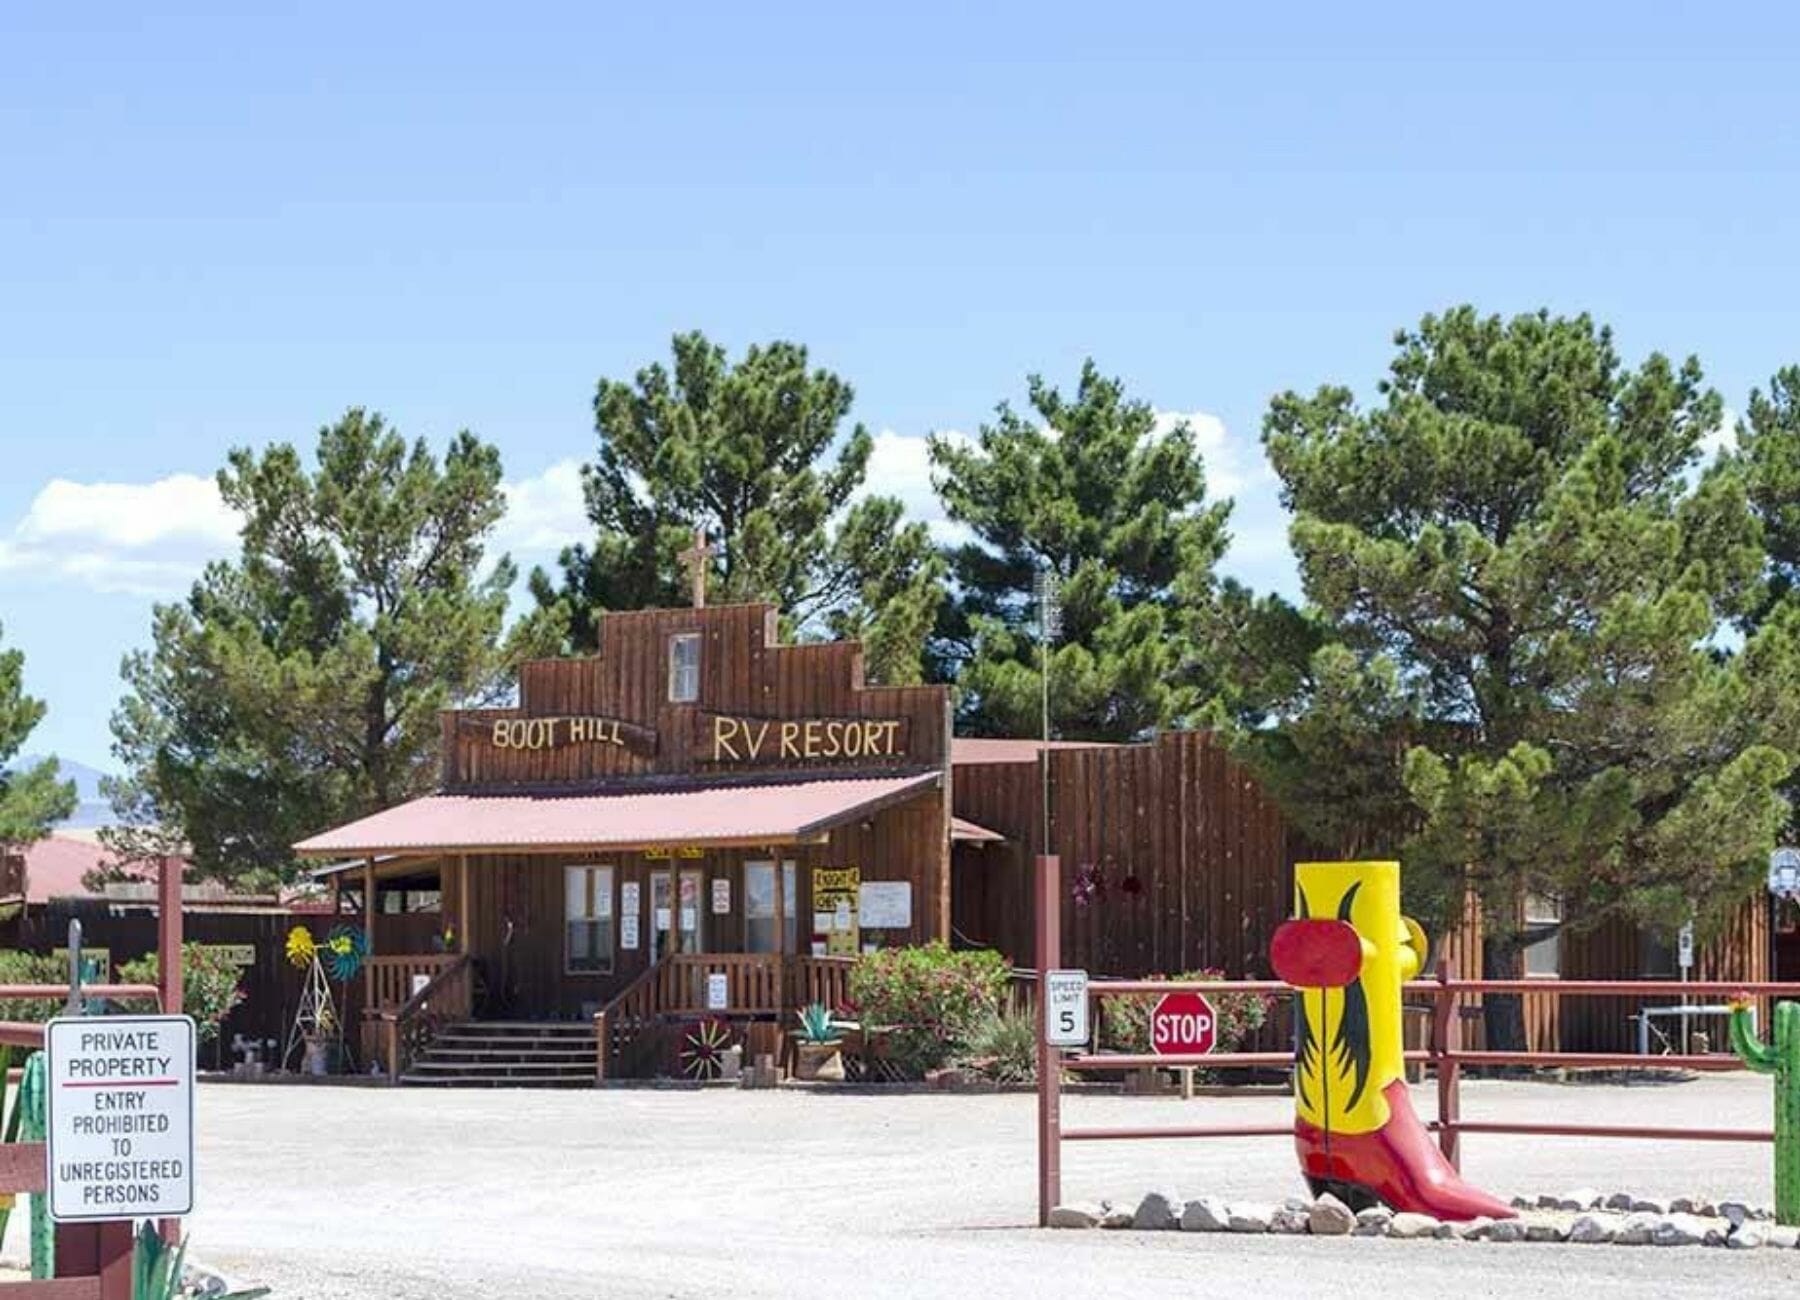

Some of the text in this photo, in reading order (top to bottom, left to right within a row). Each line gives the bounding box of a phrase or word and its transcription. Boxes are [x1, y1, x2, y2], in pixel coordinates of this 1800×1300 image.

[492, 717, 625, 749] BOOT HILL
[714, 715, 769, 761] RV
[1051, 981, 1083, 991] SPEED
[1054, 993, 1080, 1004] LIMIT
[1060, 1010, 1075, 1032] 5
[1156, 1013, 1211, 1044] STOP
[81, 1032, 159, 1051] PRIVATE
[69, 1057, 171, 1077] PROPERTY
[95, 1091, 146, 1110] ENTRY
[73, 1114, 168, 1134] PROHIBITED
[112, 1138, 132, 1156] TO
[60, 1160, 182, 1182] UNREGISTERED
[83, 1183, 159, 1205] PERSONS
